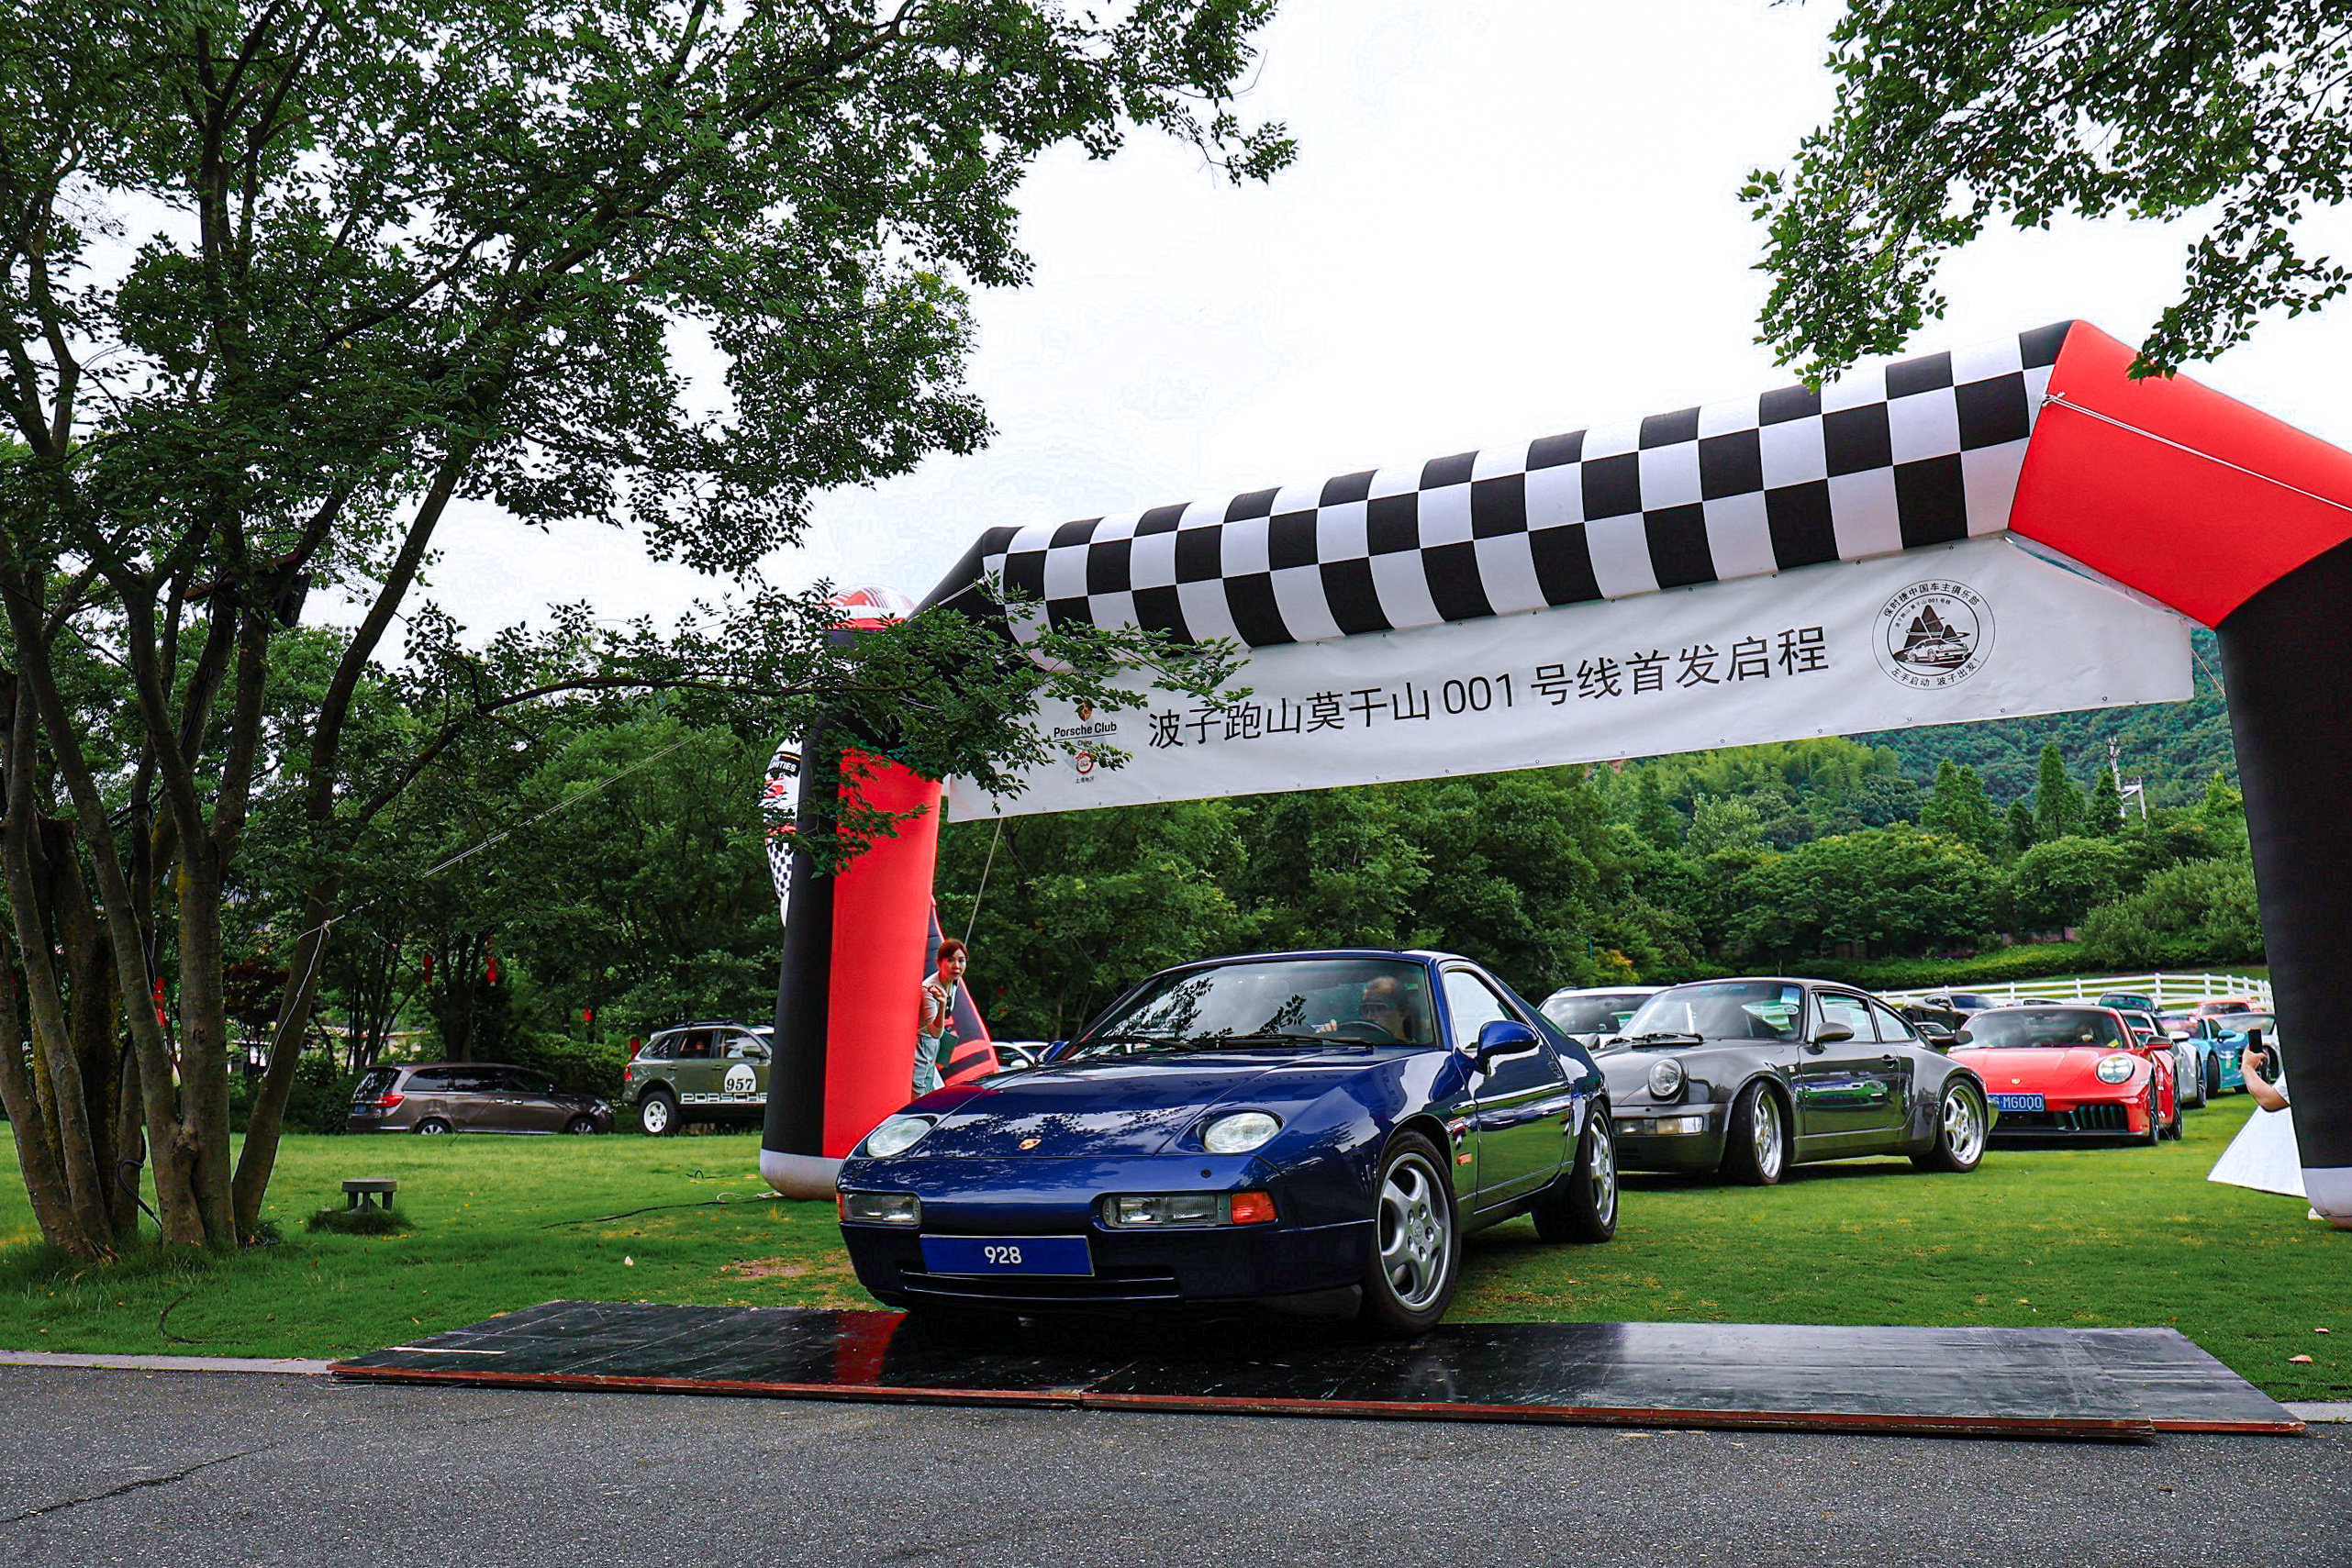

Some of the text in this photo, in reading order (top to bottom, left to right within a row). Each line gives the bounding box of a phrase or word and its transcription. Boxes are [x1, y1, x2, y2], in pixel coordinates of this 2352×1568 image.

[1883, 583, 1979, 617] 保时捷中国车主俱乐部
[1891, 668, 1930, 686] 左手启动
[1148, 626, 1829, 750] 波子跑山莫干山 001 号线首发启程
[1053, 721, 1117, 738] Porsche Club
[726, 1078, 753, 1091] 957
[680, 1093, 768, 1104] PORSCHE
[984, 1245, 1022, 1264] 928
